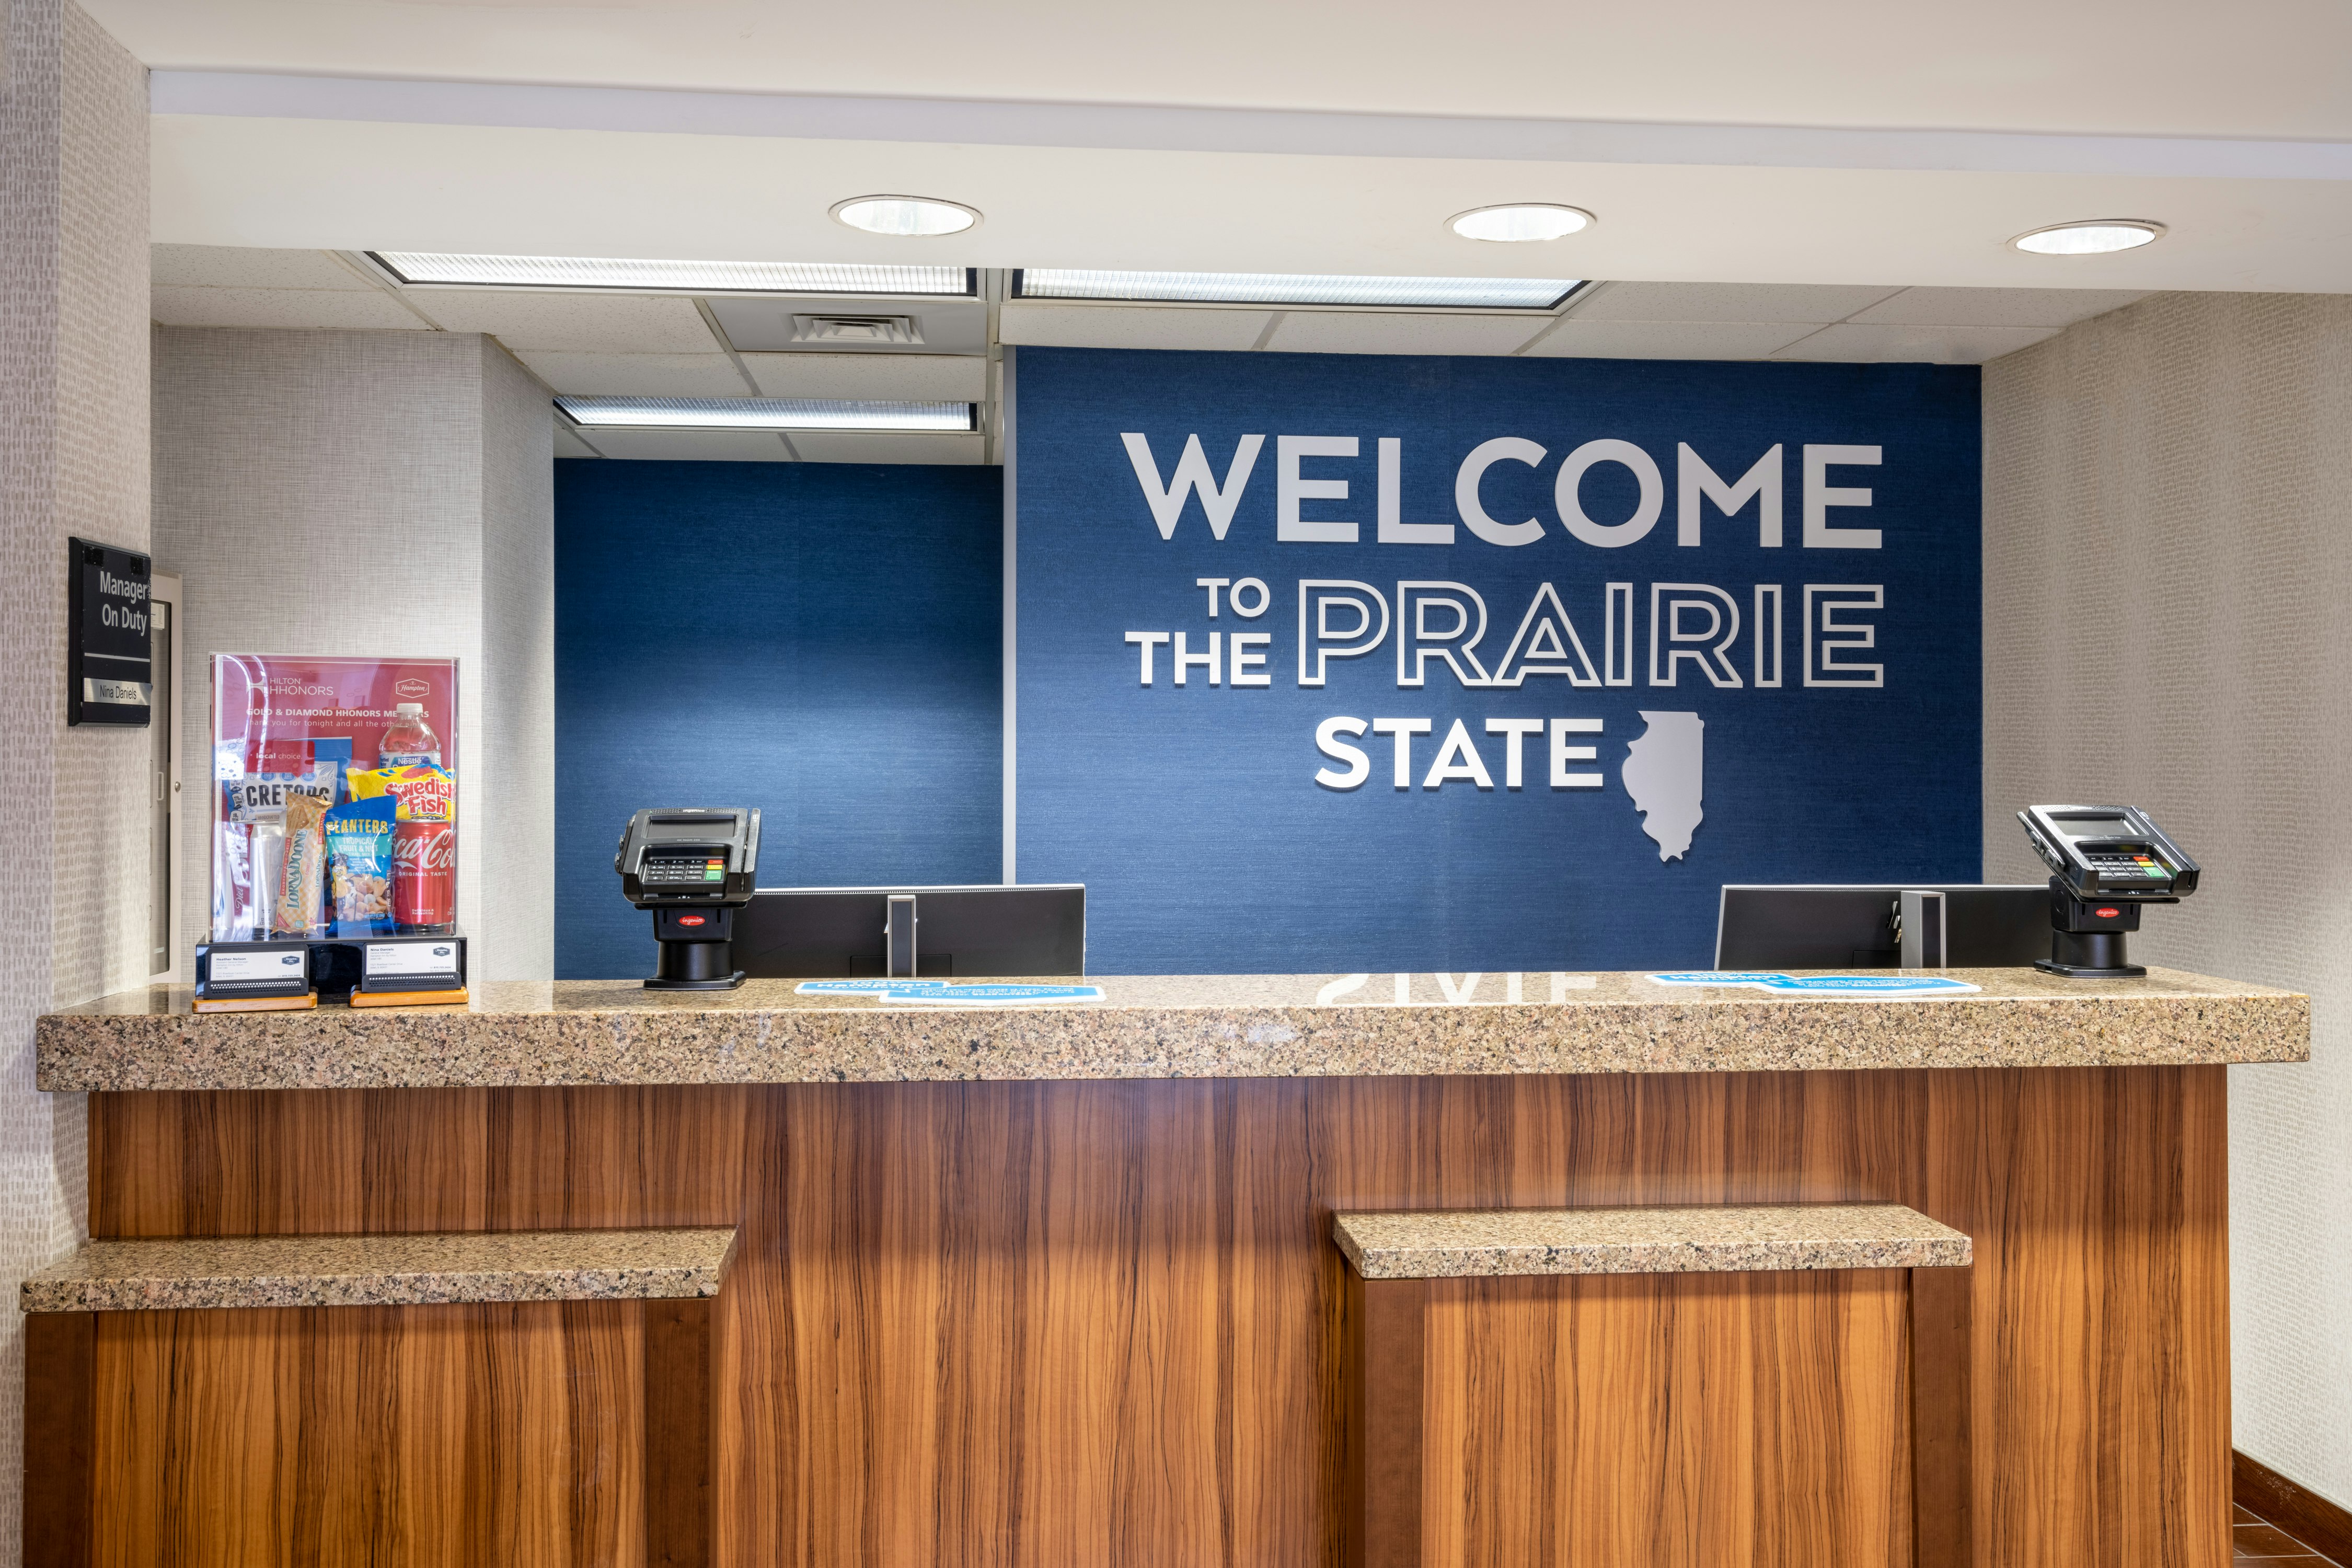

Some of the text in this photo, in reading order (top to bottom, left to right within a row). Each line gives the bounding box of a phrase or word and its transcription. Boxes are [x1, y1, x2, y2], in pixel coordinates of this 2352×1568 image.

[1120, 433, 1882, 549] WELCOME
[100, 571, 147, 604] Manager
[1197, 578, 1271, 618] TO
[102, 603, 118, 627] On
[122, 606, 147, 636] Duty
[1298, 579, 1884, 688] PRAIRIE
[1125, 631, 1271, 685] THE
[100, 685, 137, 700] Nina Daniels
[270, 686, 333, 696] HHONORS
[304, 720, 333, 728] tonight
[1313, 716, 1604, 789] STATE
[405, 795, 446, 815] Fish
[326, 819, 388, 836] PLANTERS
[342, 837, 373, 845] TROPICAL
[287, 829, 308, 872] DOONE
[235, 887, 244, 909] Diet
[286, 869, 303, 909] LORNA
